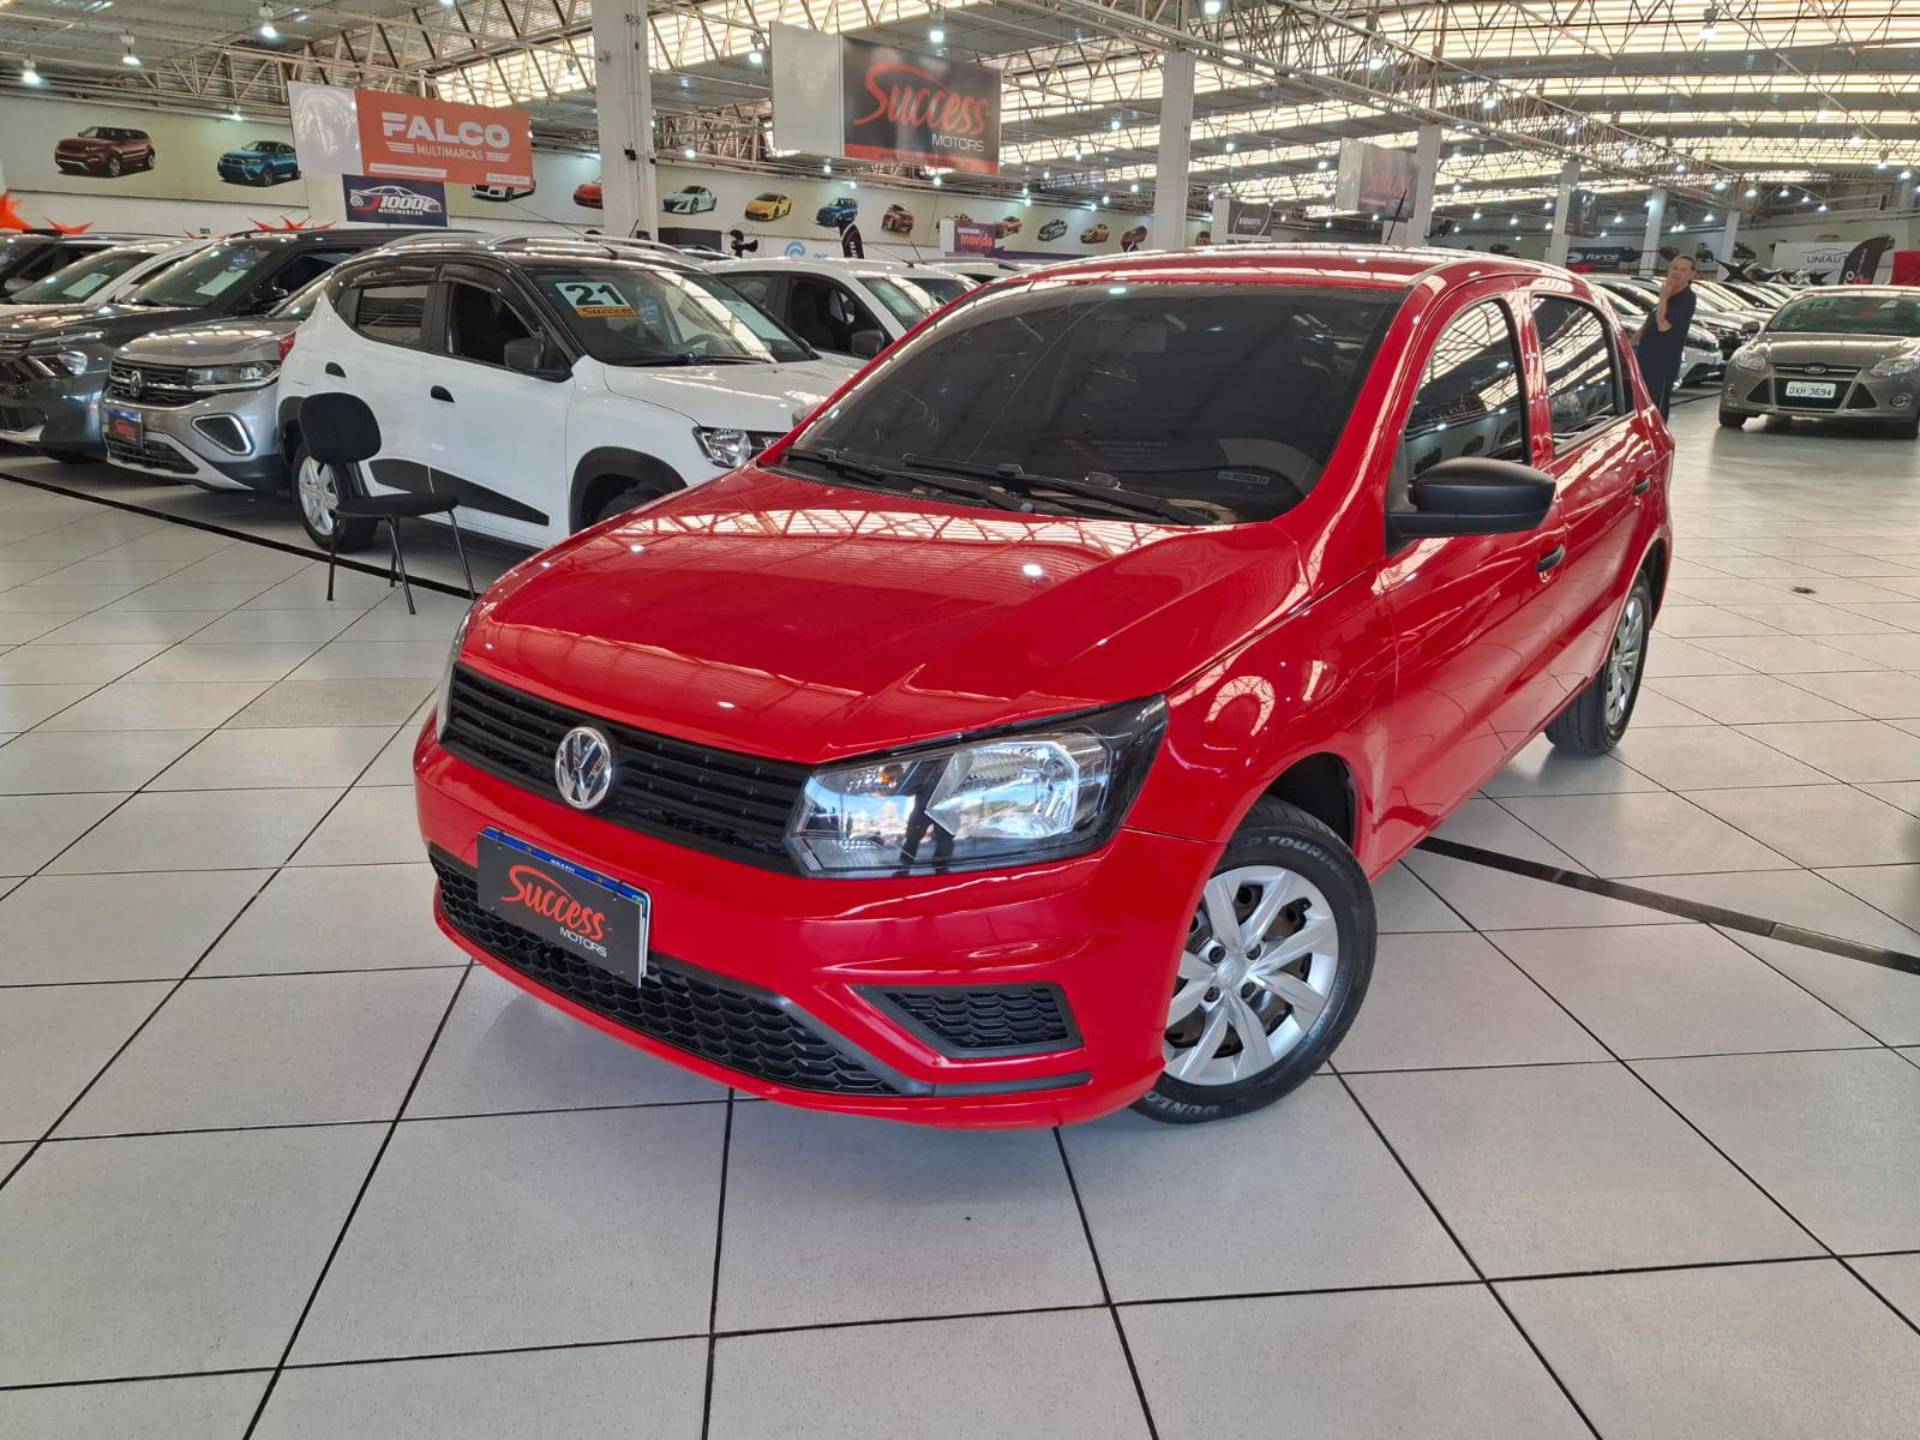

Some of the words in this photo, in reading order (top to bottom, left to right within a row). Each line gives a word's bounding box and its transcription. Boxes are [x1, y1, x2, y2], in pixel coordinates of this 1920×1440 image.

[853, 61, 989, 135] Success
[382, 111, 510, 147] FALCO
[931, 133, 985, 152] MOTORS
[416, 145, 484, 161] MULTIMARCAS
[565, 284, 625, 306] 21
[501, 865, 606, 940] Success
[560, 927, 607, 957] MOTORS
[1143, 1090, 1219, 1115] DUNLO
